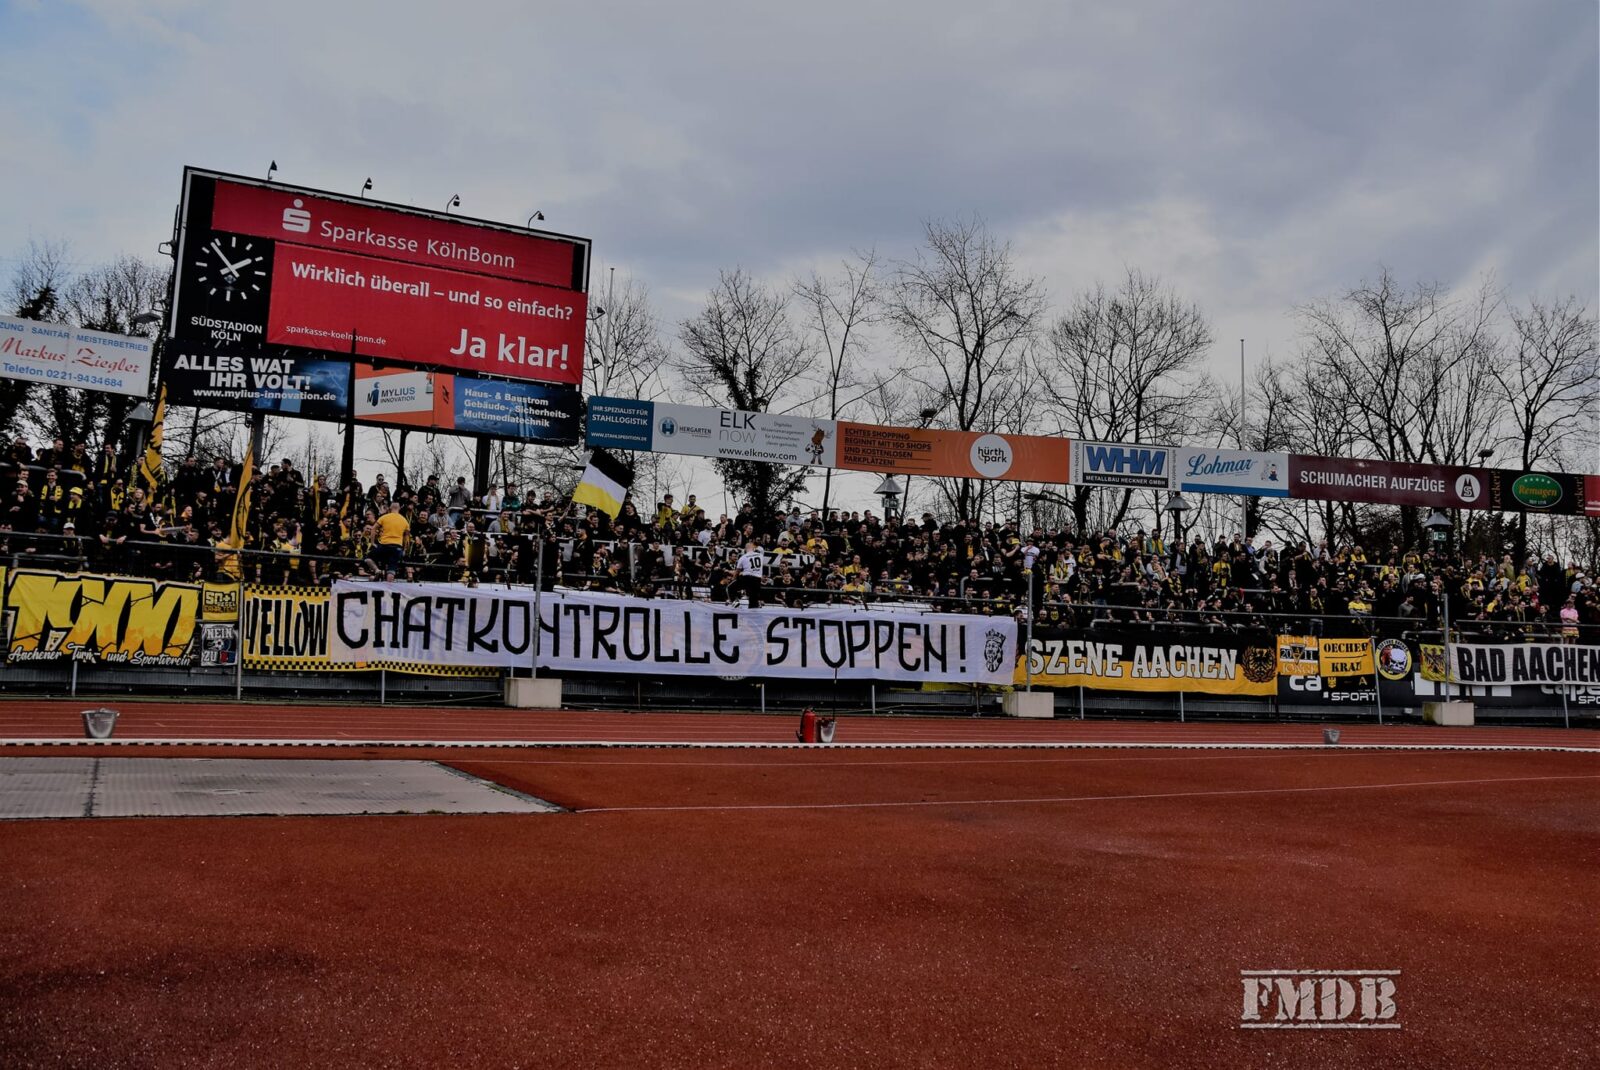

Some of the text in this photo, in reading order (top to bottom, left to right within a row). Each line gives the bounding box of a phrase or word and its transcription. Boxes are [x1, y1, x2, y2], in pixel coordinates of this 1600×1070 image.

[320, 220, 515, 269] Sparkasse KölnBonn
[291, 262, 366, 289] Wirklich
[370, 274, 430, 298] überall
[448, 288, 480, 306] und
[484, 296, 503, 310] so
[507, 297, 573, 321] einfach?
[190, 315, 263, 334] SÜDSTADION
[76, 334, 149, 352] MEISTERBETRIEB
[211, 329, 242, 342] KÖLN
[1, 337, 140, 374] Markus Ziegler
[449, 328, 569, 370] Ja klar!
[174, 354, 295, 374] ALLES WAT
[3, 362, 123, 388] Telefon 0221-9434684
[209, 372, 311, 392] IHR VOLT!
[193, 389, 337, 401] www.mylius-innovation.de
[380, 395, 416, 404] INNOVATION
[381, 387, 416, 397] MYLIUS
[464, 388, 549, 406] Haus- & Baustrom
[514, 404, 571, 420] Sicherheits-
[603, 406, 636, 414] SPEZIALIST
[463, 409, 550, 428] Multimediatechnik
[592, 414, 648, 426] STAHLLOGISTIK
[721, 411, 756, 430] ELK
[679, 426, 712, 434] HERGARTEN
[719, 429, 756, 443] now
[845, 428, 910, 440] ECHTES SHOPPING
[844, 446, 912, 458] UND KOSTENLOSEN
[845, 437, 876, 448] BEGINNT
[878, 440, 891, 448] MIT
[906, 442, 931, 451] SHOPS
[978, 446, 1004, 458] hürth
[719, 447, 797, 461] www.elknow.com
[983, 455, 1007, 464] park
[1086, 446, 1166, 475] WHM
[1186, 454, 1253, 477] Lohmar
[1086, 475, 1120, 483] METALLBAU
[1300, 471, 1445, 493] SCHUMACHER AUFZÜGE
[1518, 485, 1557, 498] Remagen
[749, 557, 761, 569] 10
[206, 628, 232, 639] NEIN
[246, 598, 329, 656] YELLOW
[337, 591, 965, 673] CHATKONTROLLE STOPPEN!
[8, 646, 62, 664] Aachener
[107, 650, 126, 663] und
[130, 650, 192, 667] Sportverein
[202, 651, 217, 662] ZU
[1026, 638, 1238, 680] SZENE AACHEN
[1456, 646, 1600, 682] BAD AACHEN
[1331, 692, 1377, 701] SPORT
